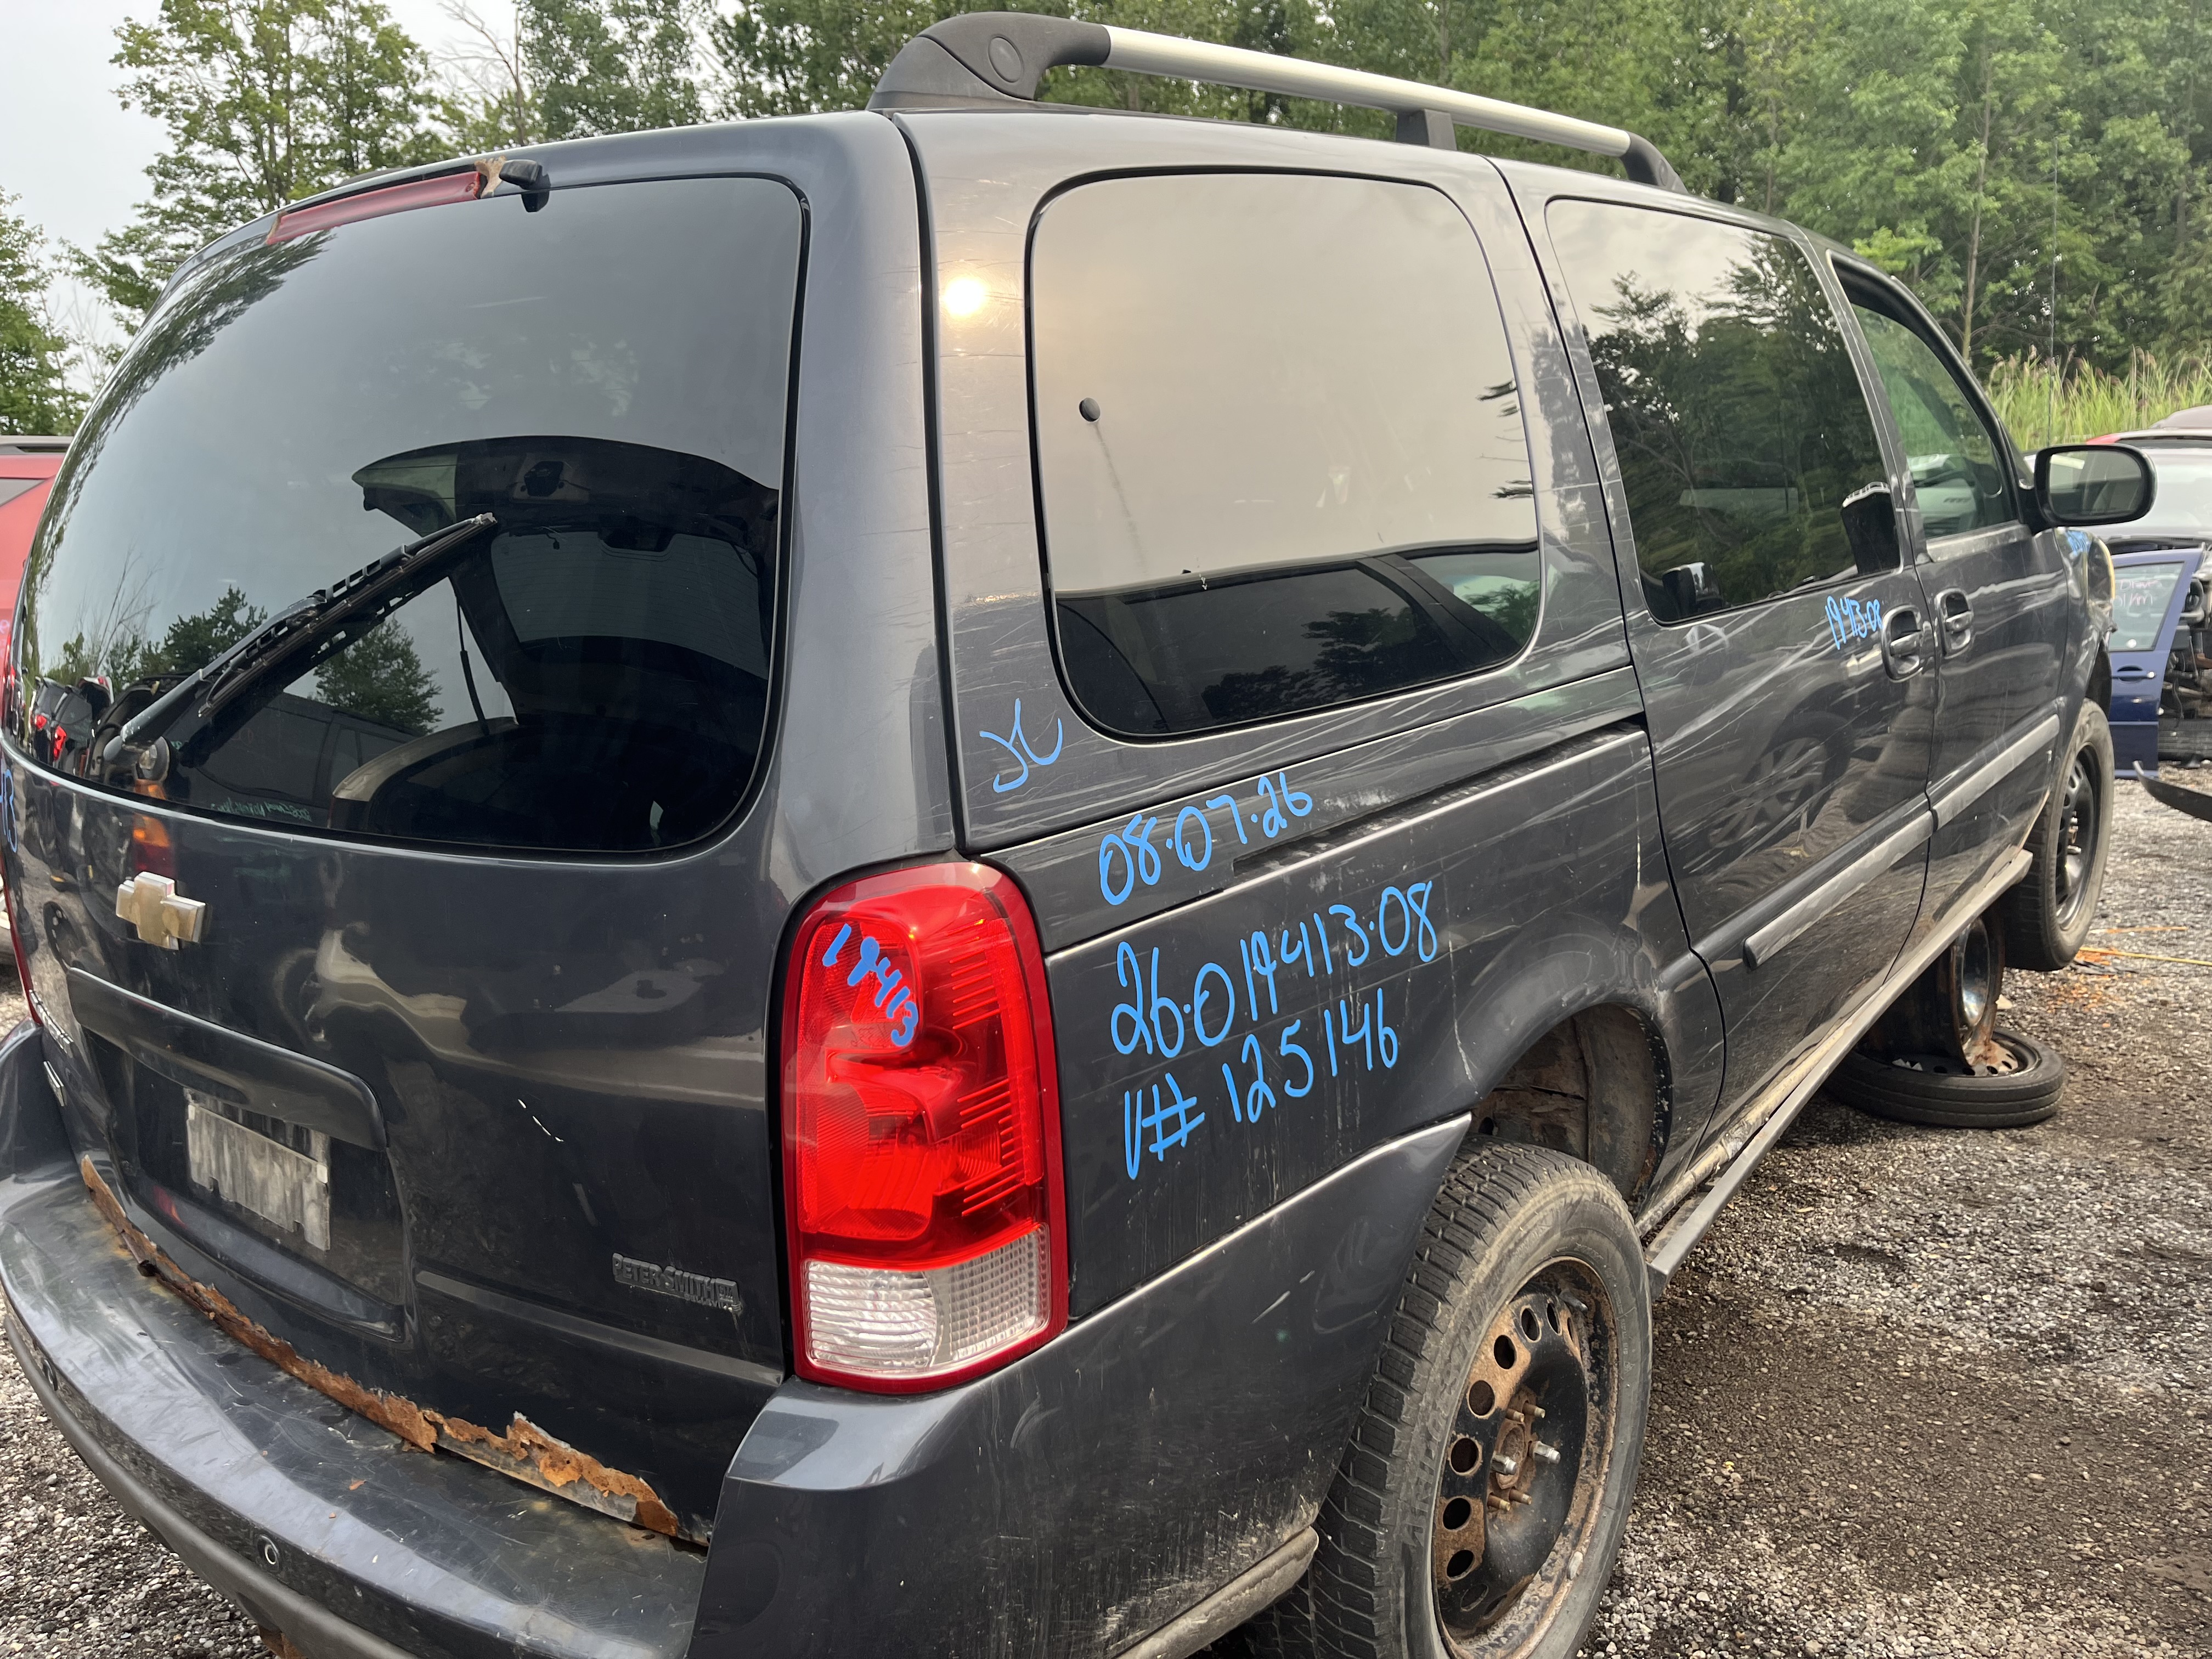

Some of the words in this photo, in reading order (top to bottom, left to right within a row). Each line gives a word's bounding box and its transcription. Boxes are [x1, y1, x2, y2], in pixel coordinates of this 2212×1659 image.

[822, 923, 919, 1047] 19413
[1124, 1072, 1205, 1180] V#
[1222, 988, 1398, 1124] 125146
[612, 1253, 662, 1287] PETER
[661, 1266, 716, 1298] SMITH
